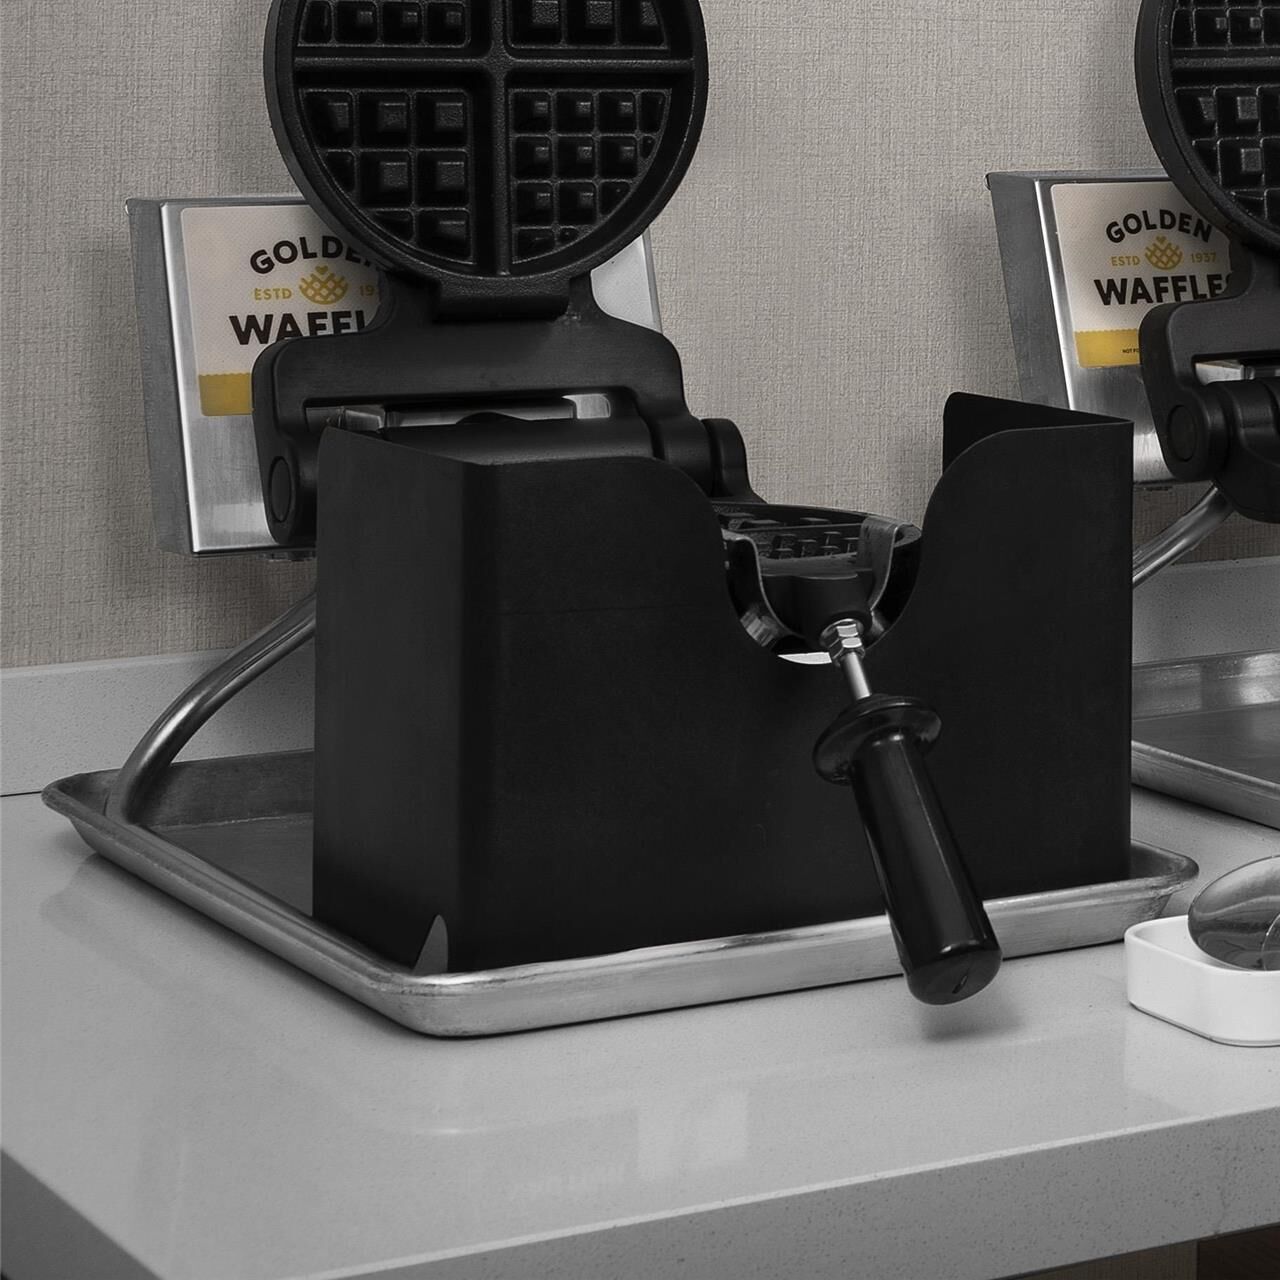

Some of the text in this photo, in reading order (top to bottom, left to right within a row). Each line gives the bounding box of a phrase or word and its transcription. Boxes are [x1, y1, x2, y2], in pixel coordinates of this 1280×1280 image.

[1106, 209, 1212, 243] GOLDEN
[250, 235, 371, 274] GOLDE
[1111, 252, 1217, 266] ESTD 1937
[254, 285, 375, 300] ESTD 19
